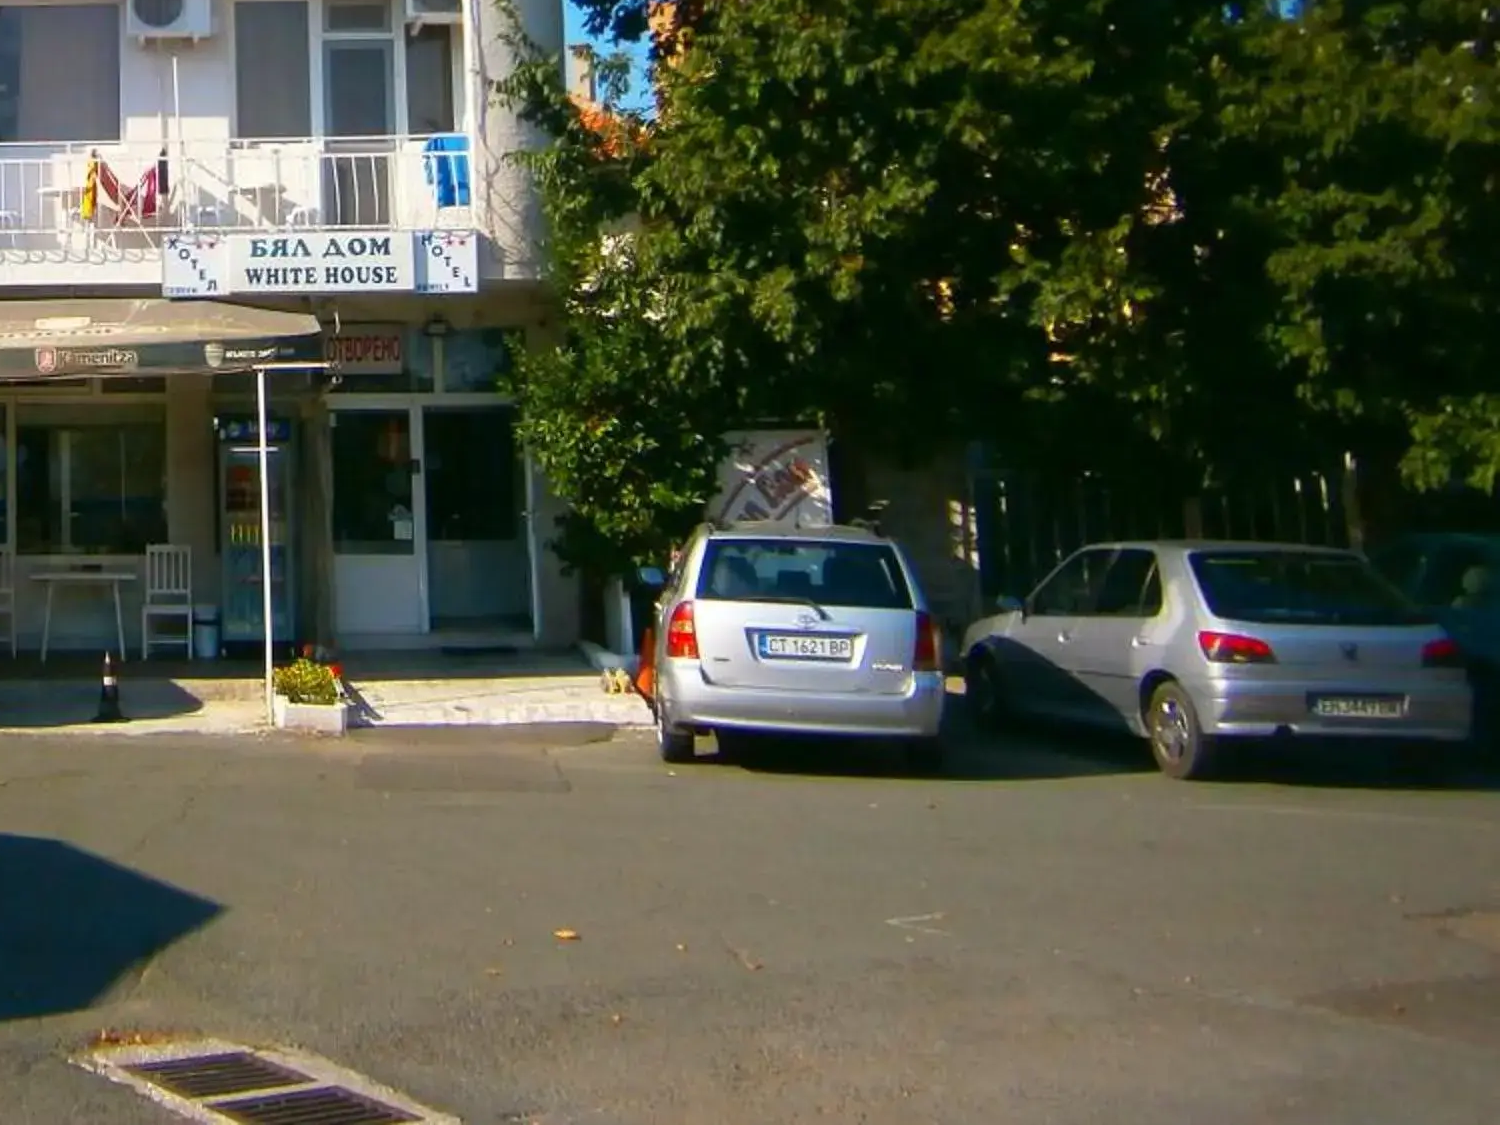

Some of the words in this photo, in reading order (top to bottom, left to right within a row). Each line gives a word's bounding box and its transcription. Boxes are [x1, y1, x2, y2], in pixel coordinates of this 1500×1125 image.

[251, 238, 311, 258] БЯЛ
[323, 236, 391, 258] ДОМ
[168, 238, 217, 291] ХОТЕЛ
[421, 233, 471, 287] HOTEL
[245, 266, 318, 286] WHITE
[324, 265, 398, 284] HOUSE
[793, 639, 825, 654] 1621
